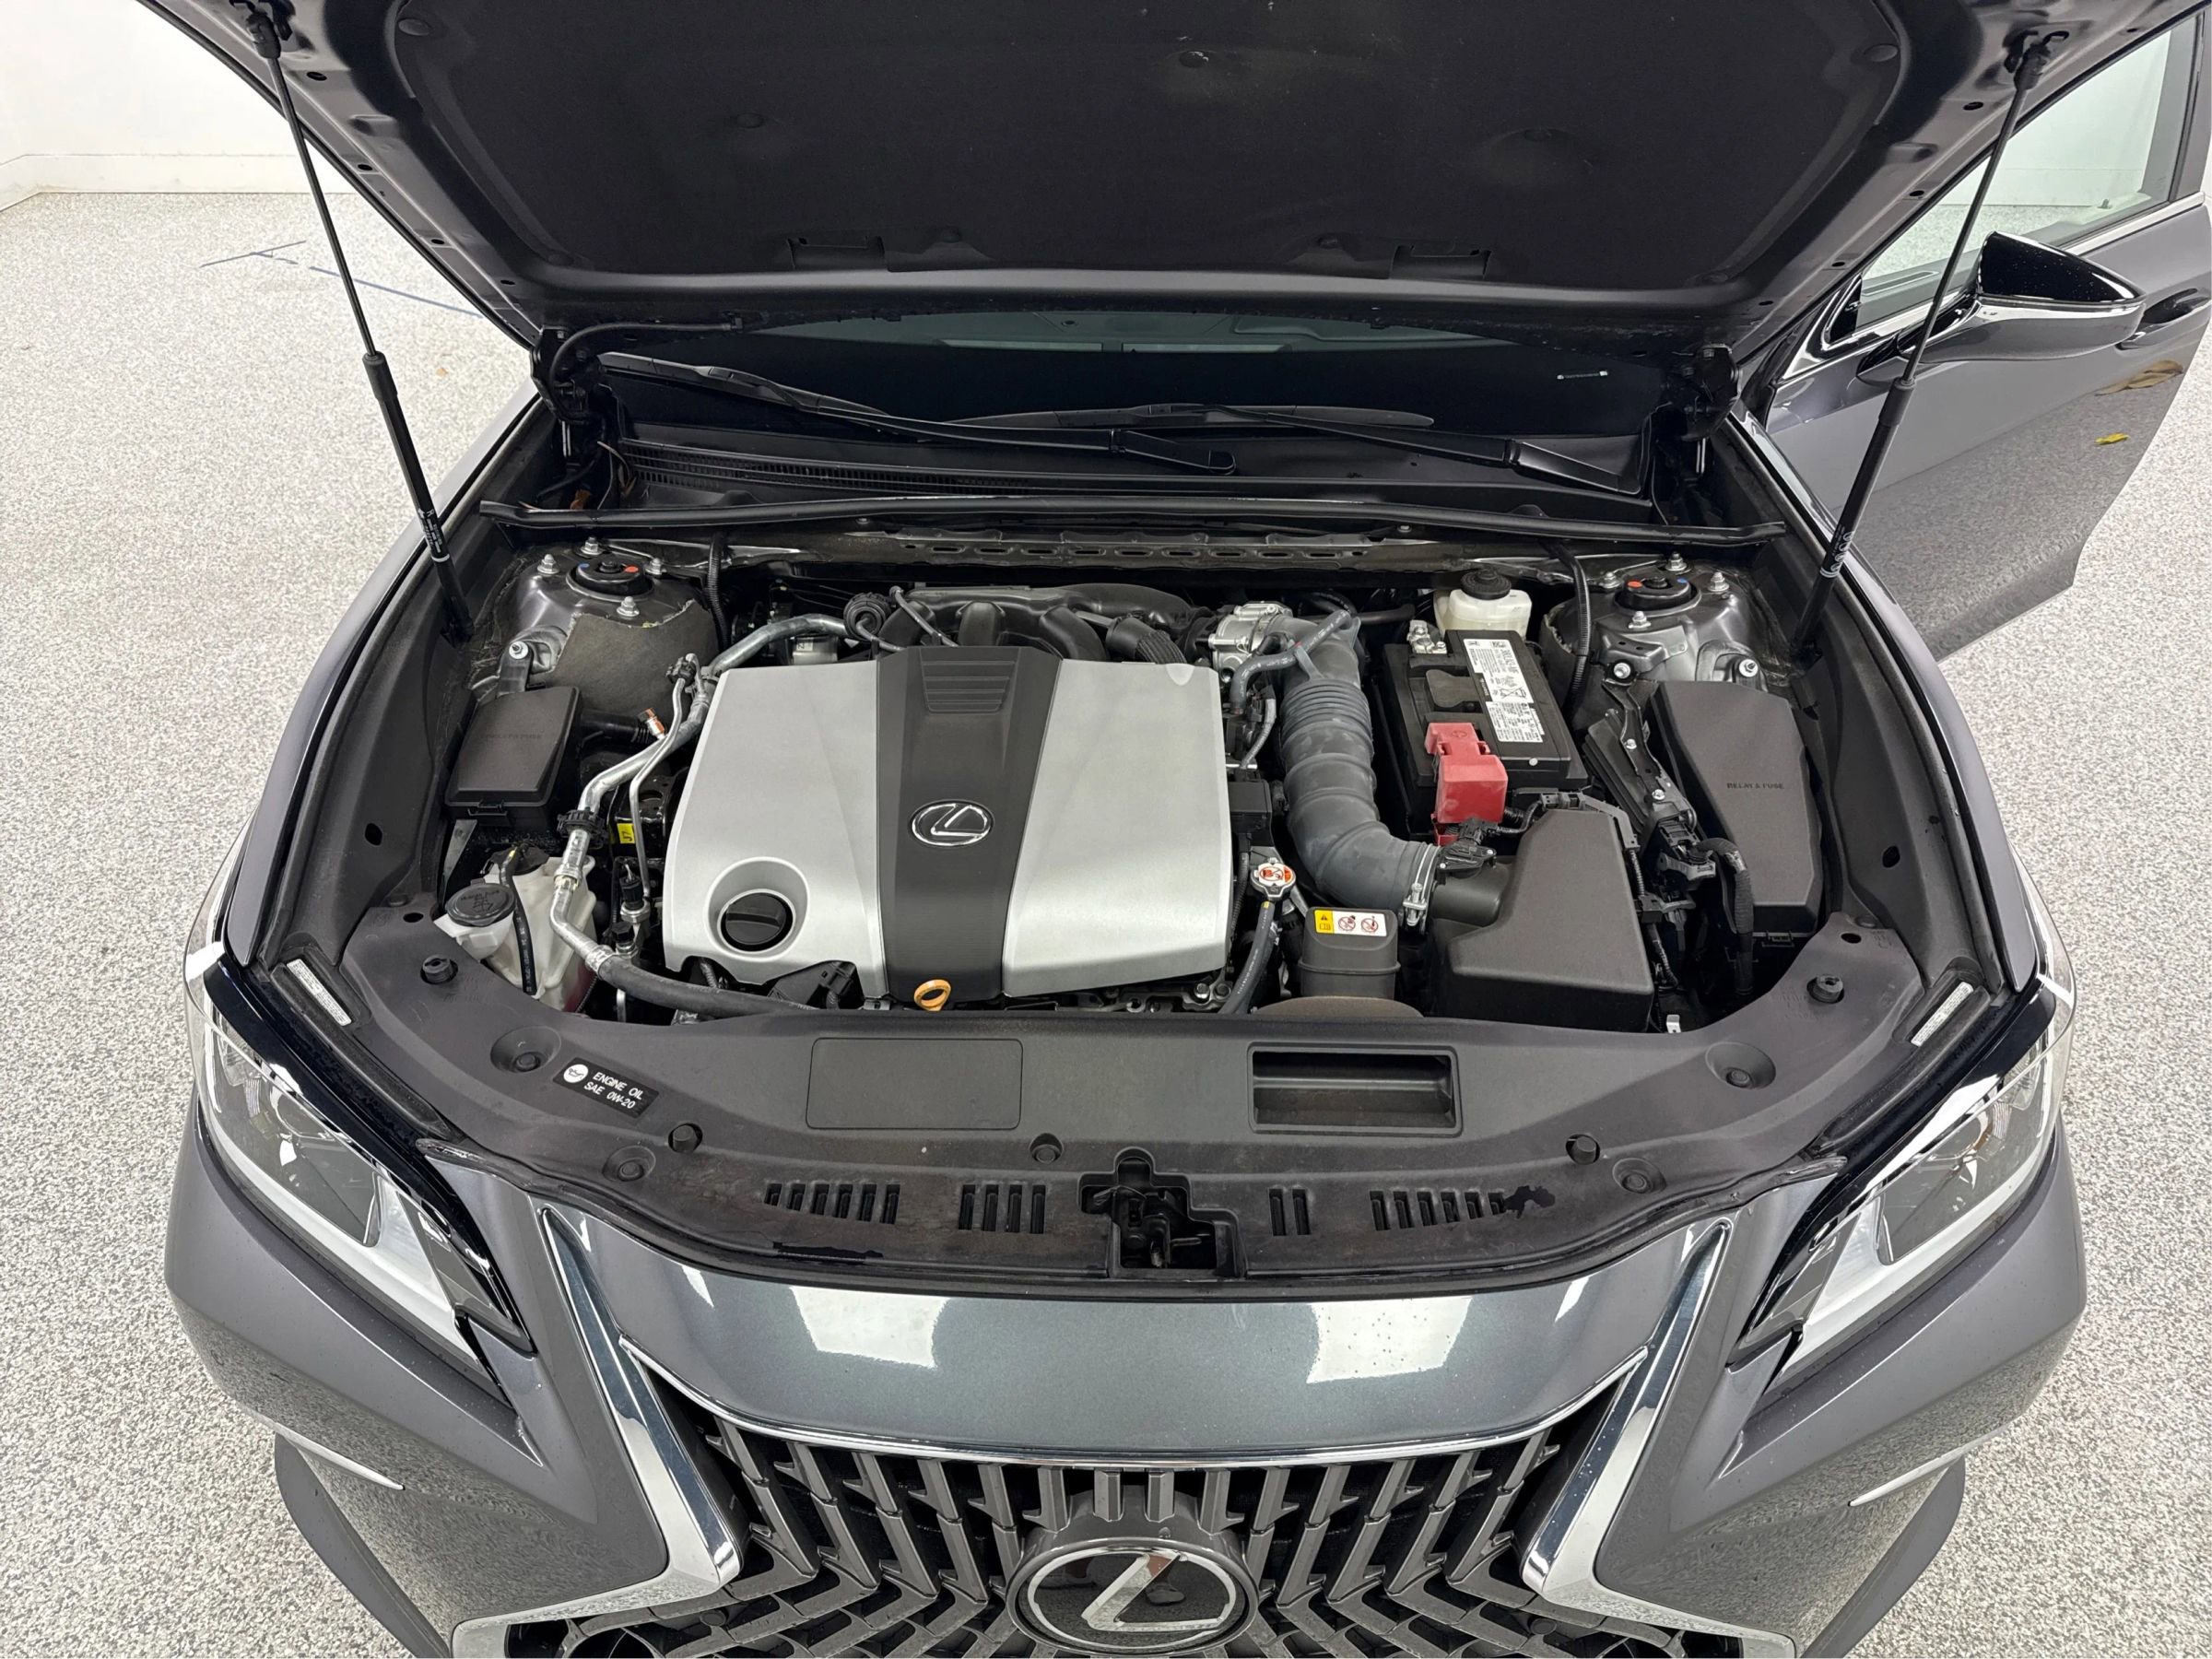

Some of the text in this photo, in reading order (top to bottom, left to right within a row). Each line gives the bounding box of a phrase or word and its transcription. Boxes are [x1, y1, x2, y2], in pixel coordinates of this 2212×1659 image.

[583, 1081, 637, 1110] SAE 0W-20
[593, 1071, 644, 1101] ENGINE OIL
